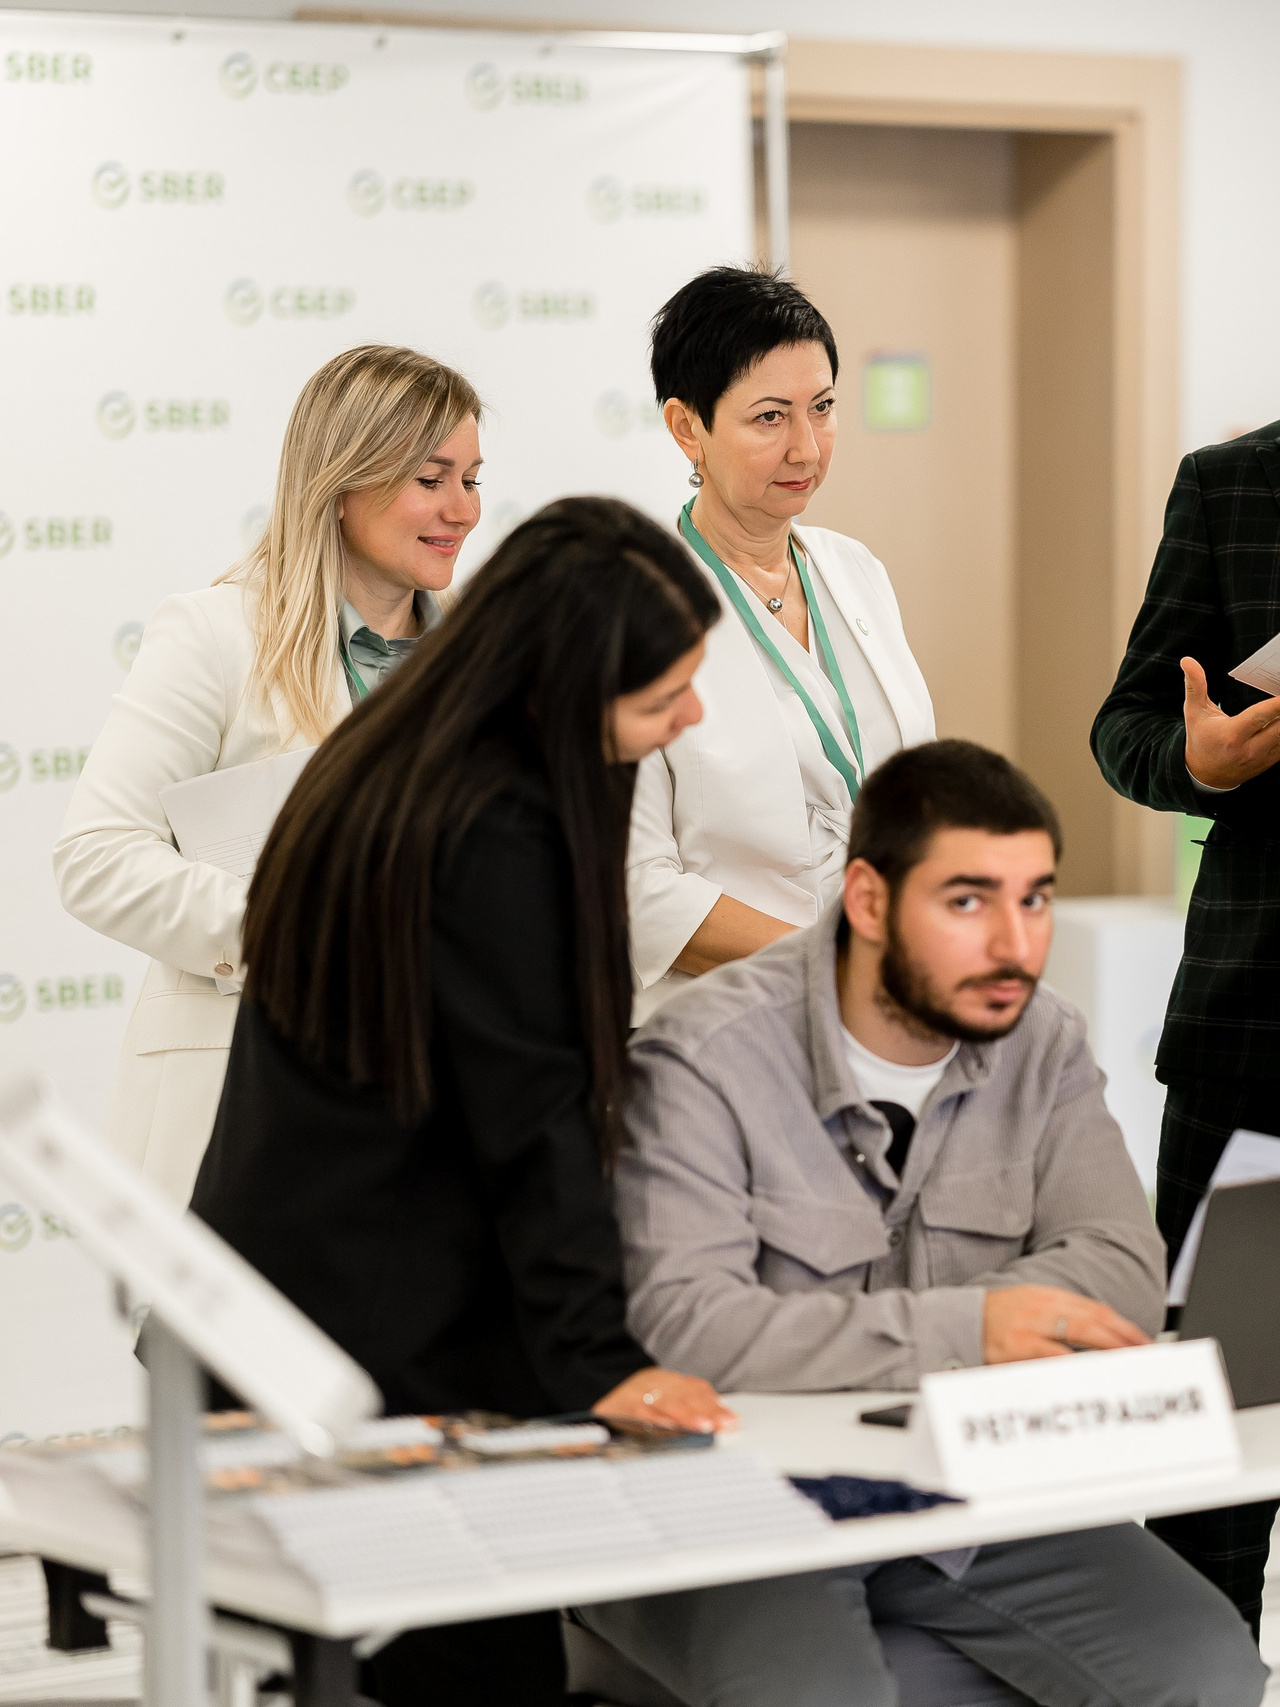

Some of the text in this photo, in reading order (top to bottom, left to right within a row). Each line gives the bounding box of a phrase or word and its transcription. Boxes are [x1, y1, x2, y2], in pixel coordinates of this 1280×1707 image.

[5, 51, 93, 84] SBER
[139, 171, 226, 203] SBER
[8, 284, 96, 316] SBER
[144, 398, 230, 432] SBER
[25, 517, 112, 550] SBER
[36, 974, 125, 1011] SBER
